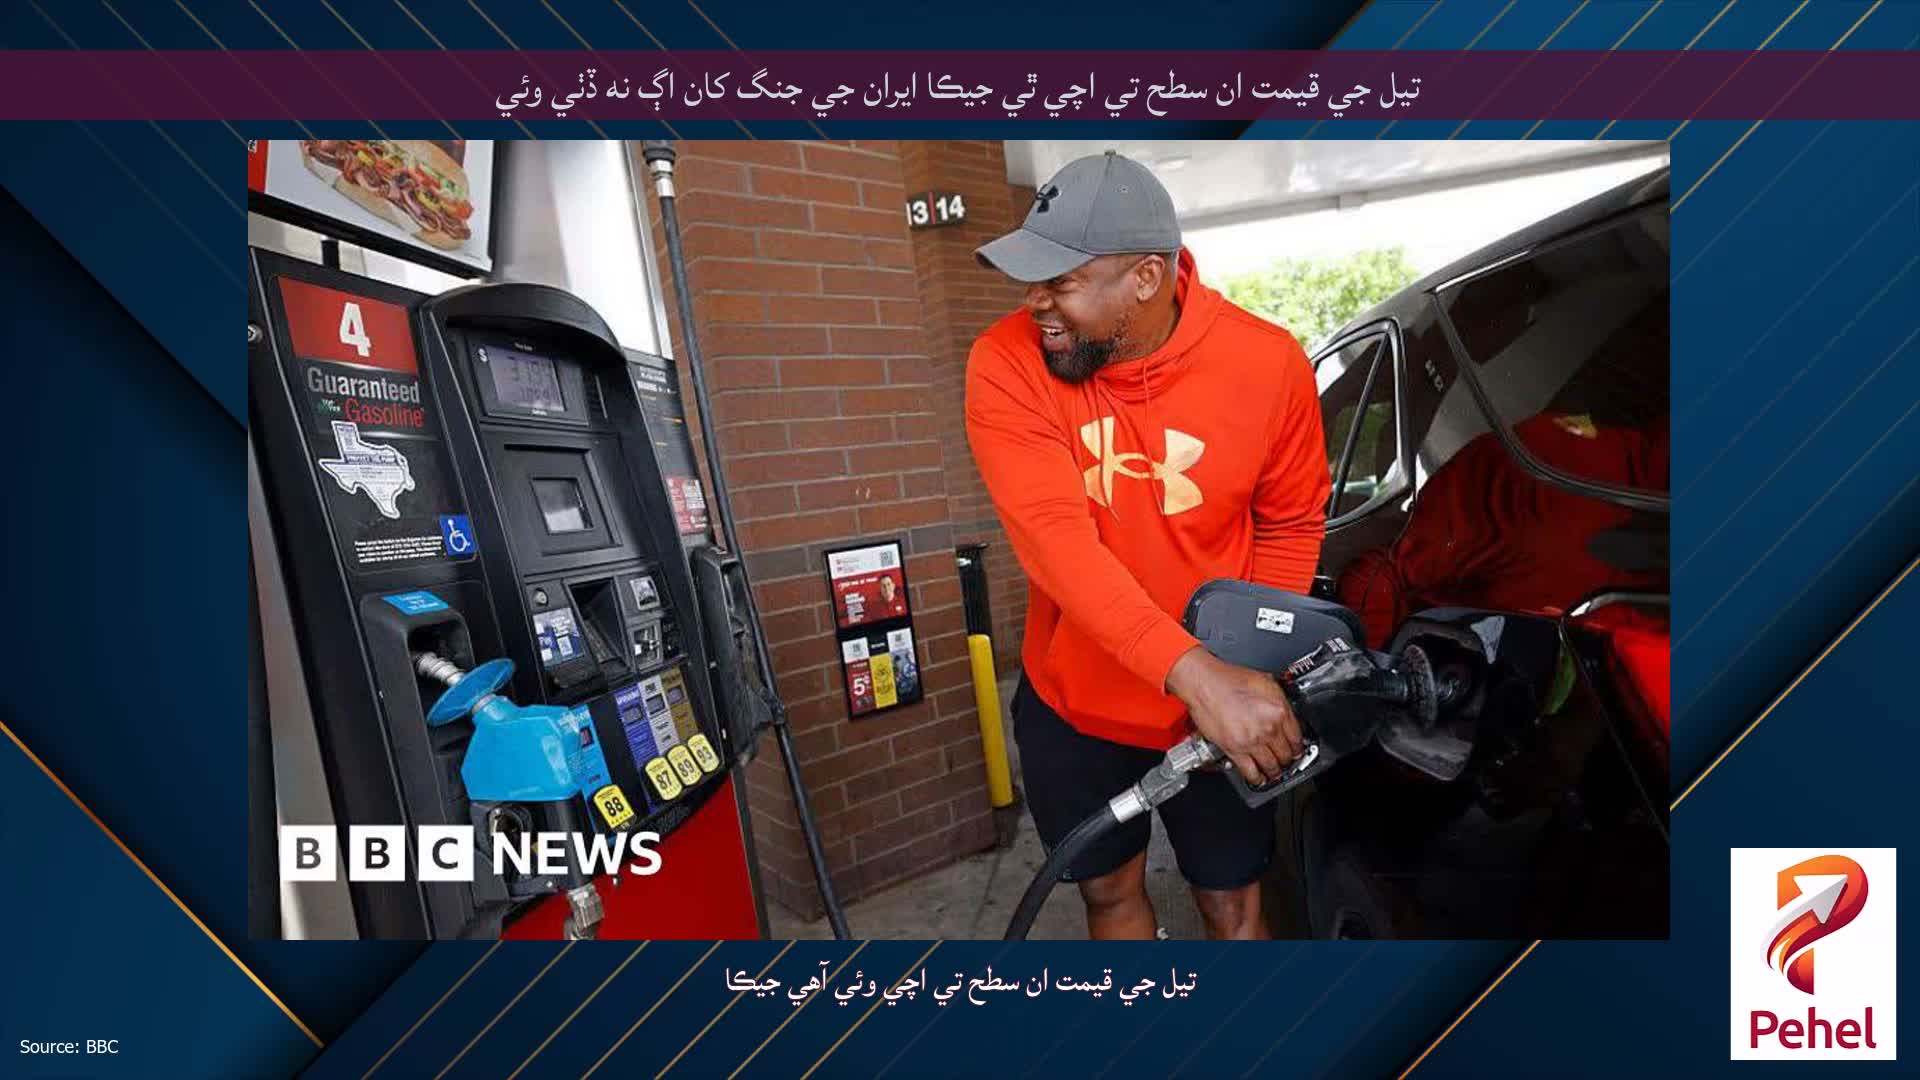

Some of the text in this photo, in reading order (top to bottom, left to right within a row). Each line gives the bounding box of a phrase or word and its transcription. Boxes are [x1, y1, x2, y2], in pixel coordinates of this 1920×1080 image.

[935, 194, 966, 221] 14
[339, 302, 371, 357] 4
[307, 366, 420, 404] Guaranteed
[344, 398, 423, 428] Gasoline
[698, 745, 714, 764] 93
[655, 769, 672, 791] 87
[677, 758, 696, 779] 89
[603, 796, 625, 818] 88
